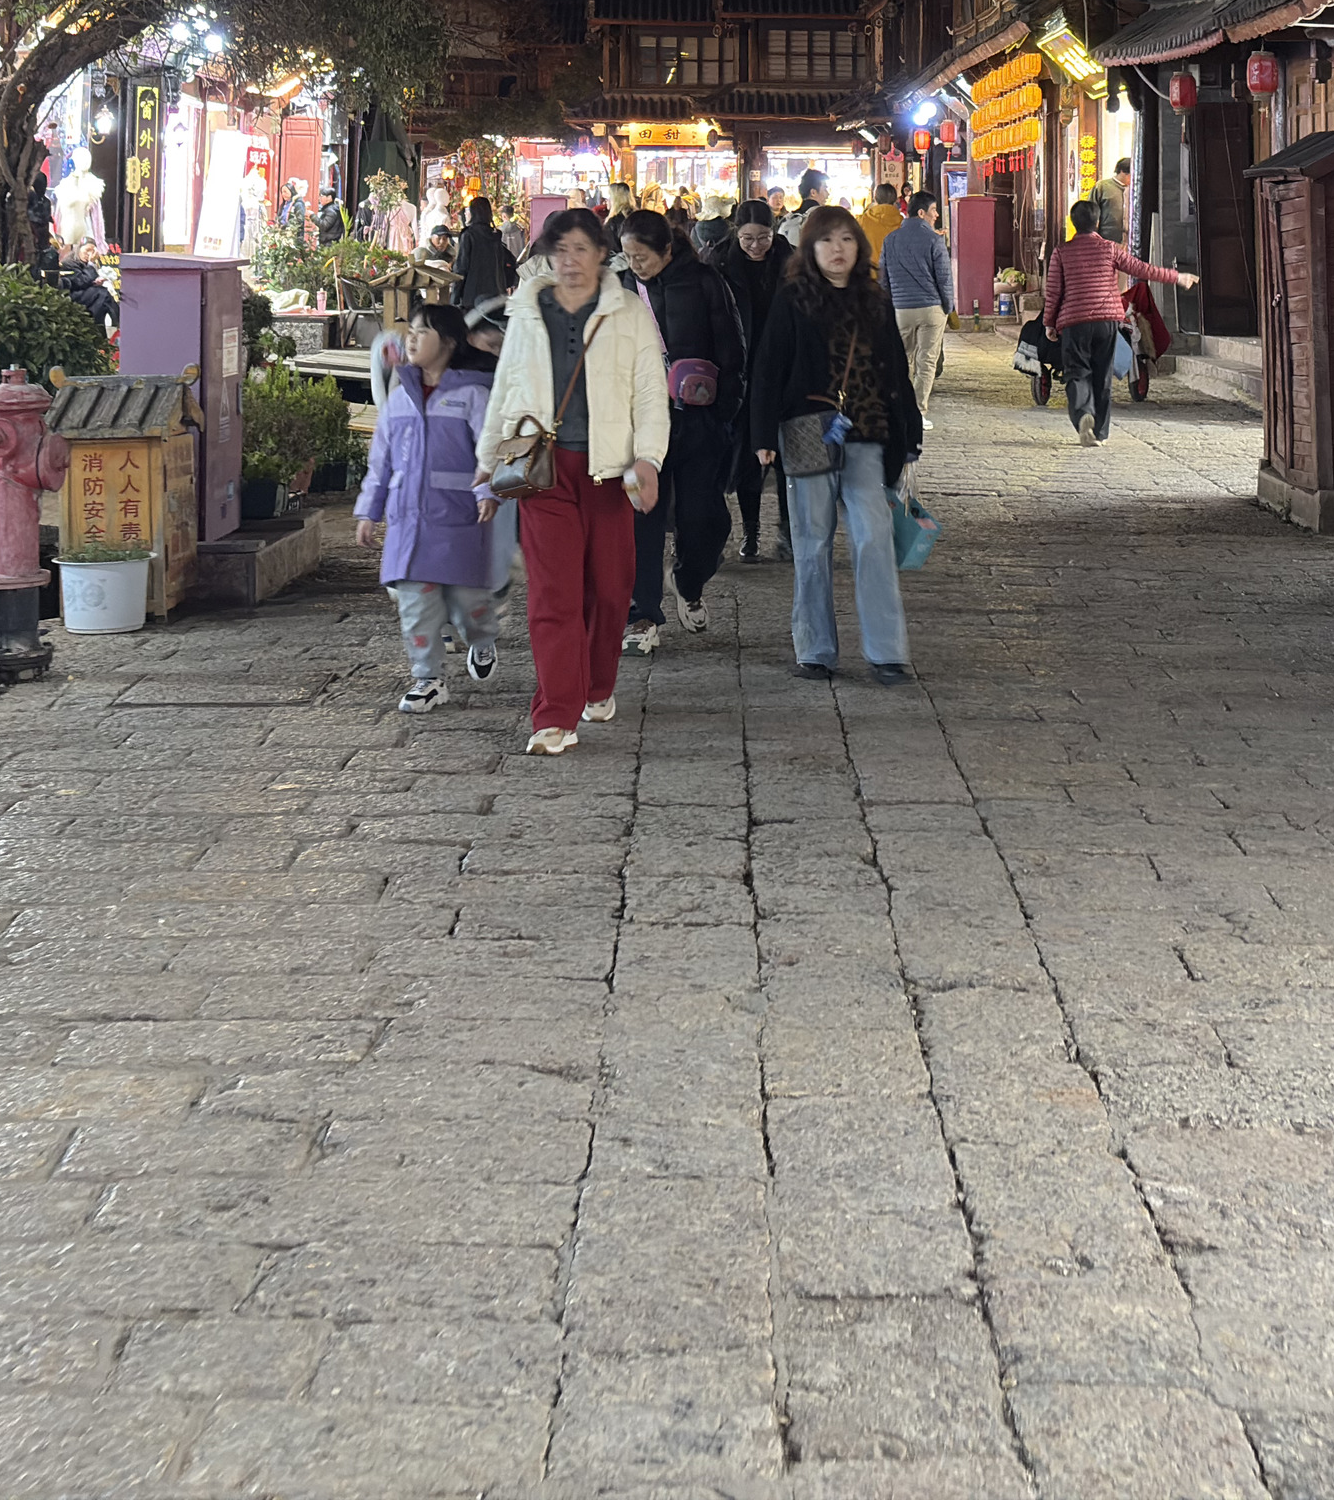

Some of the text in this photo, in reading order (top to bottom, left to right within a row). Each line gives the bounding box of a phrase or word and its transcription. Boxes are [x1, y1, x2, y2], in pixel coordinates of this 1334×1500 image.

[82, 452, 105, 544] 消防安全
[119, 450, 142, 542] 人人有责
